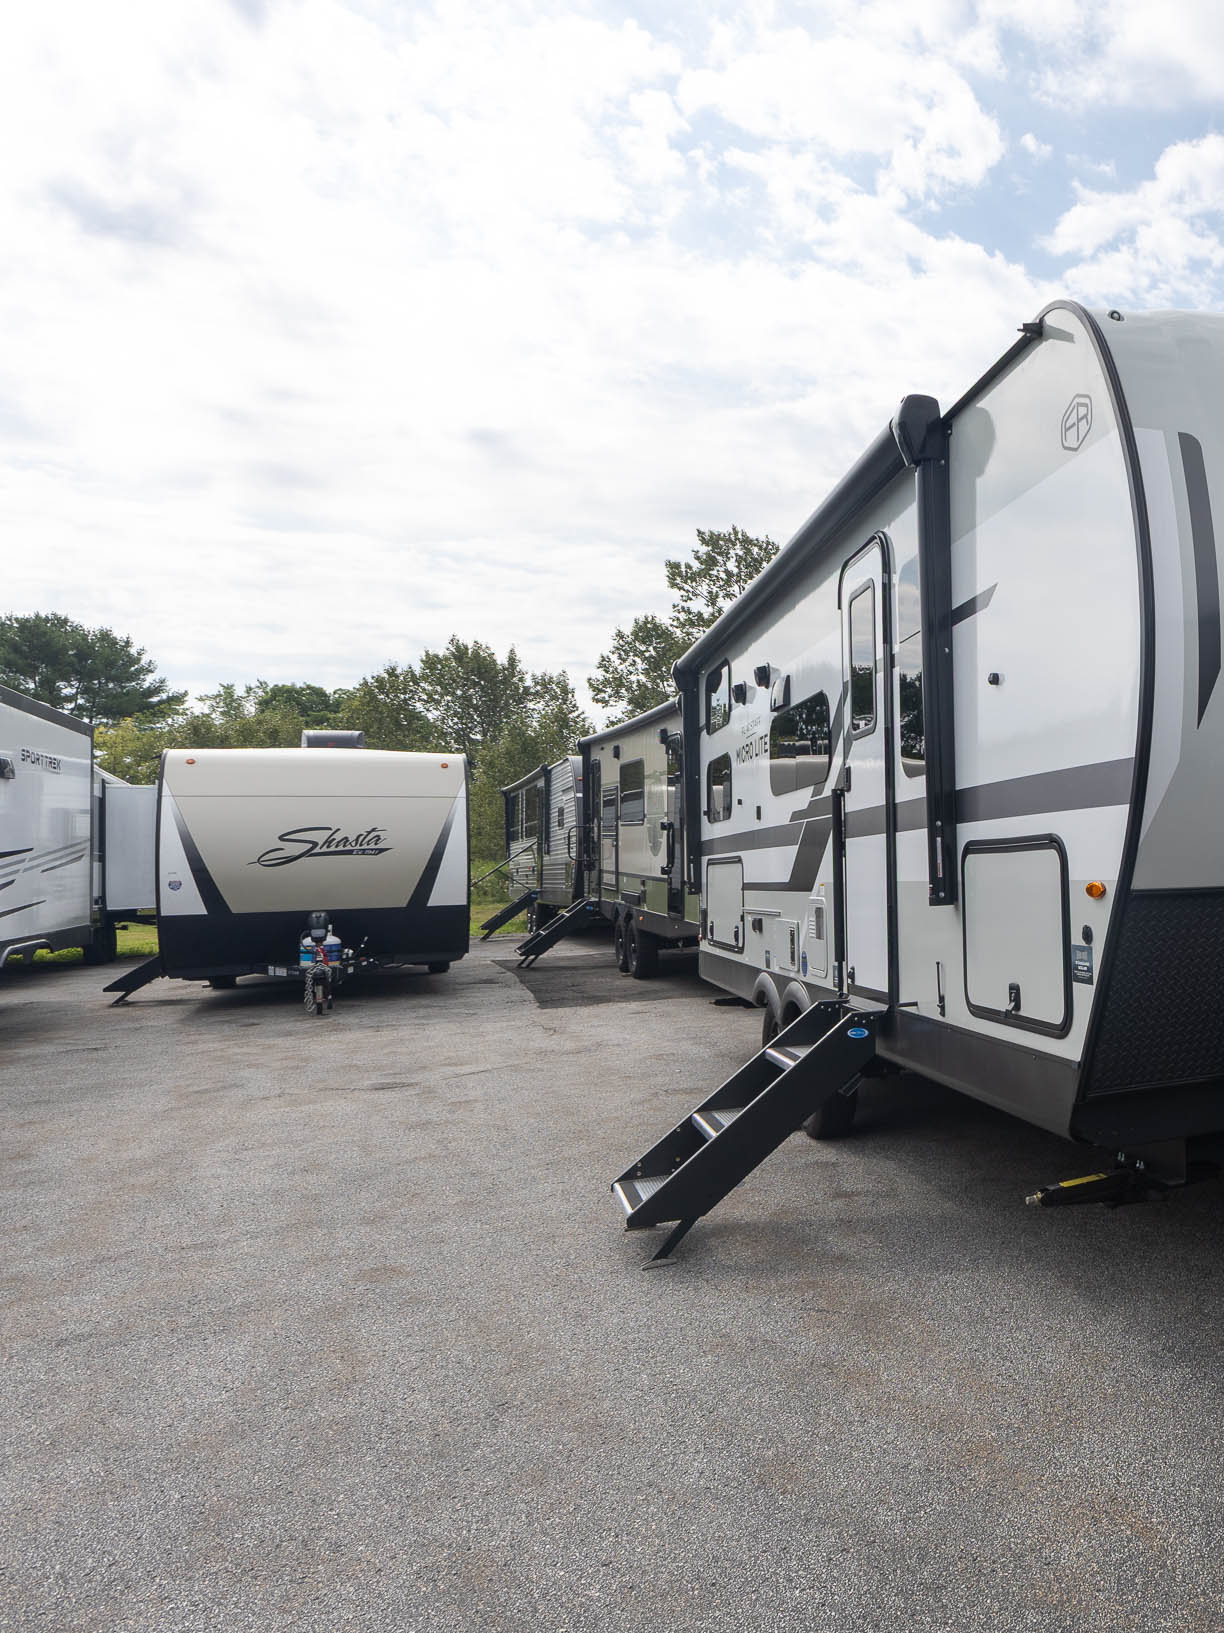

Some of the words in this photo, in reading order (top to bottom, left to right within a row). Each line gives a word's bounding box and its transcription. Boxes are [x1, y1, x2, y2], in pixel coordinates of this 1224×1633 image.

[21, 748, 62, 772] SPORTTREK
[736, 741, 754, 766] MICRO
[754, 734, 768, 757] LITE
[246, 826, 388, 868] Shasta
